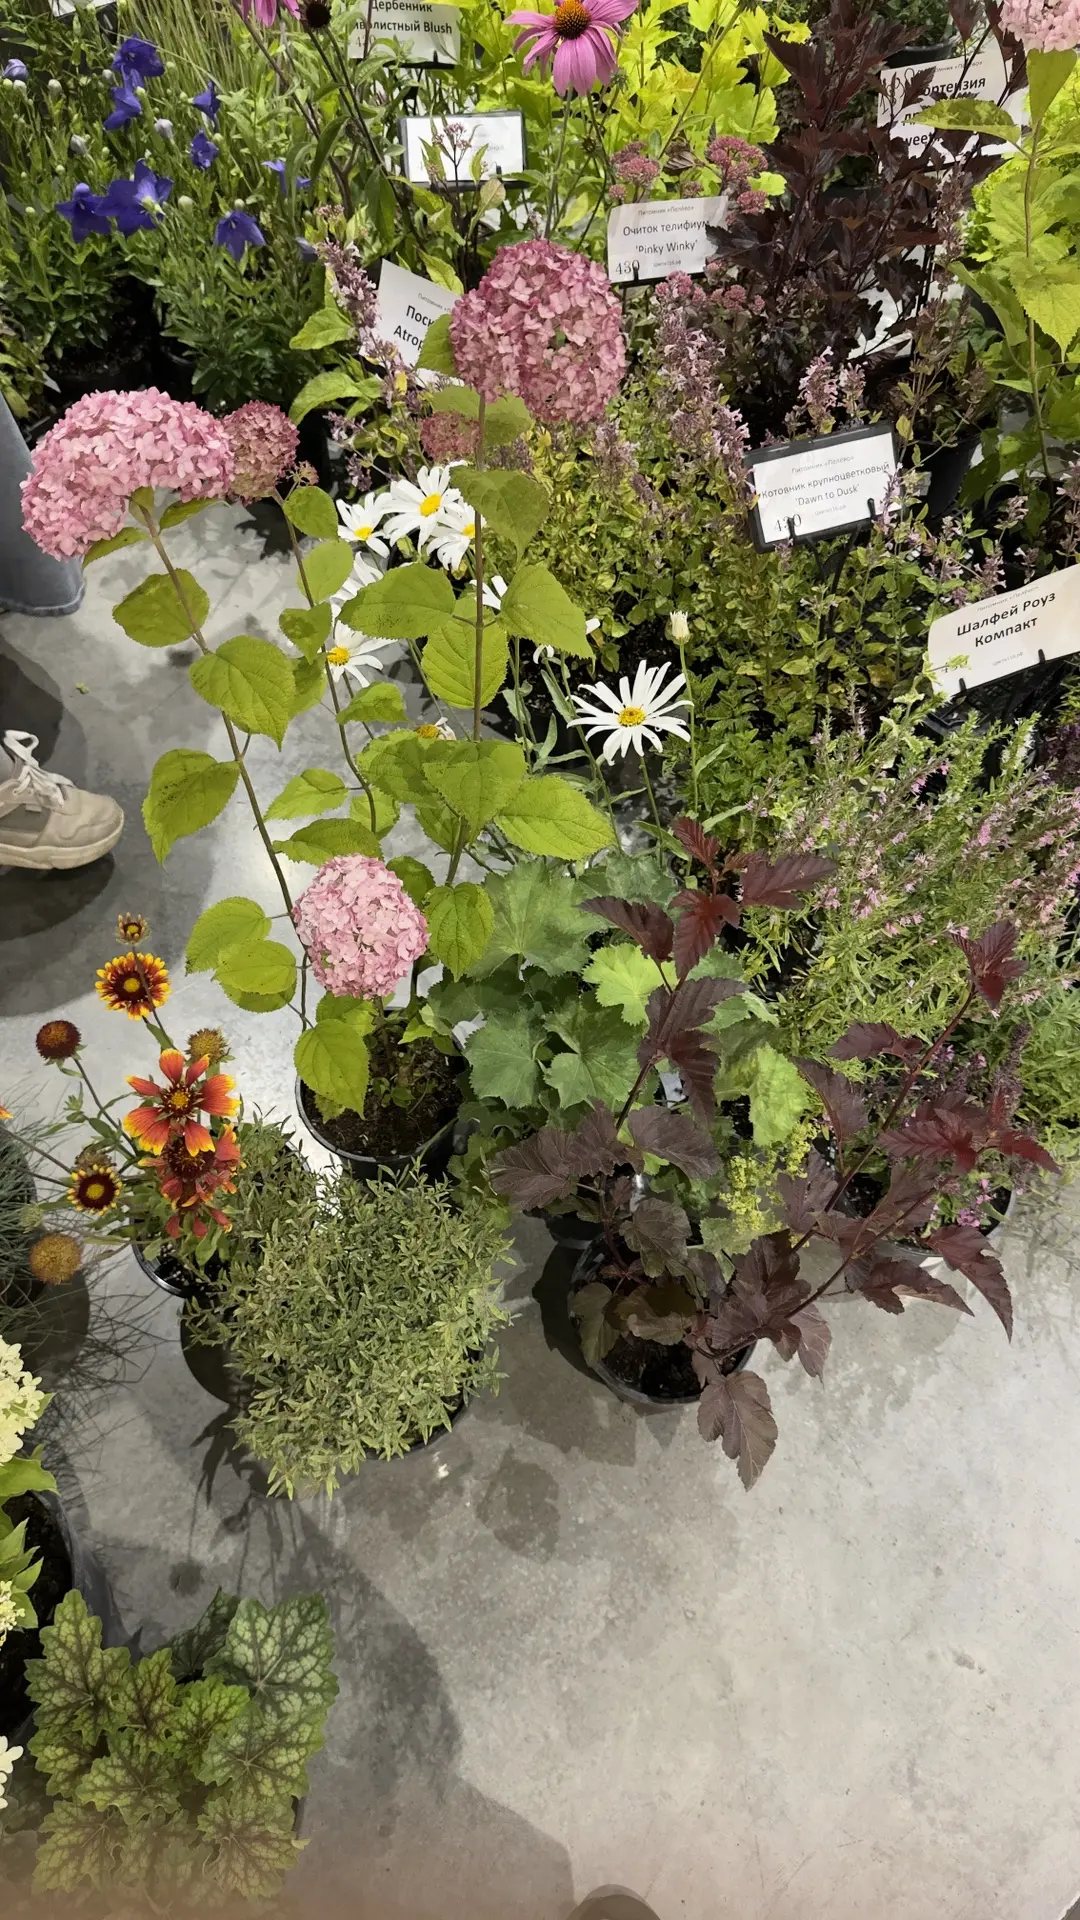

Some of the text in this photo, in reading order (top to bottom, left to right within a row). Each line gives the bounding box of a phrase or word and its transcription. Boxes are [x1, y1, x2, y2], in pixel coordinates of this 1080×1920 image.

[372, 0, 433, 12] Дербенник
[424, 22, 453, 34] Blush
[923, 77, 986, 96] ортензия
[623, 224, 658, 236] Очиток
[615, 259, 640, 275] 430
[761, 461, 890, 499] Котовник крупноцветковый
[825, 491, 835, 501] to
[957, 592, 1056, 637] Шалфей Роуз
[975, 616, 1038, 647] Компакт
